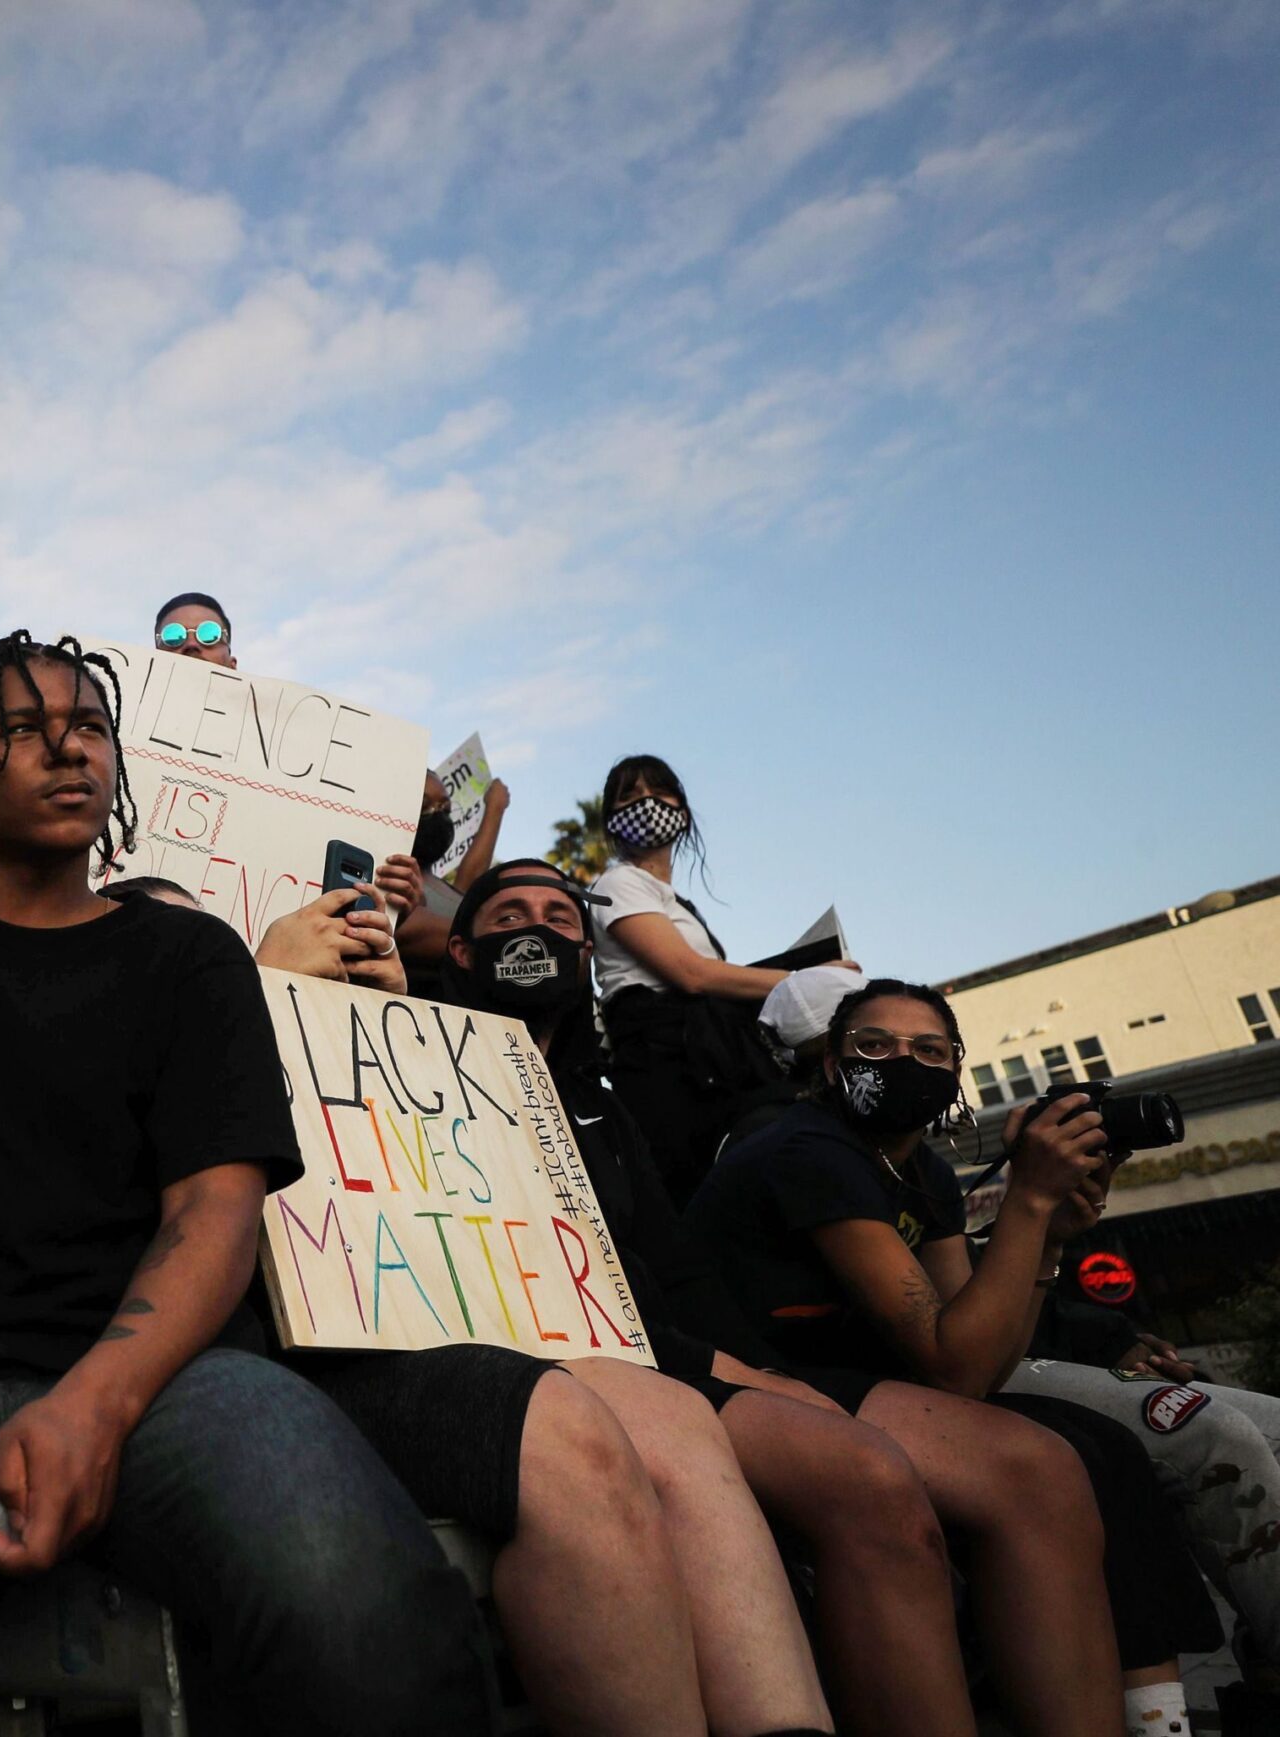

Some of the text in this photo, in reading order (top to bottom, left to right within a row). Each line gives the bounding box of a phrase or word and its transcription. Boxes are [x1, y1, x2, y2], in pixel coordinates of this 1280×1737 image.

[164, 787, 210, 839] IS
[499, 962, 552, 977] TRAPANESE
[282, 982, 519, 1126] LACK
[321, 1097, 492, 1204] LIVES
[277, 1193, 636, 1348] MATTER
